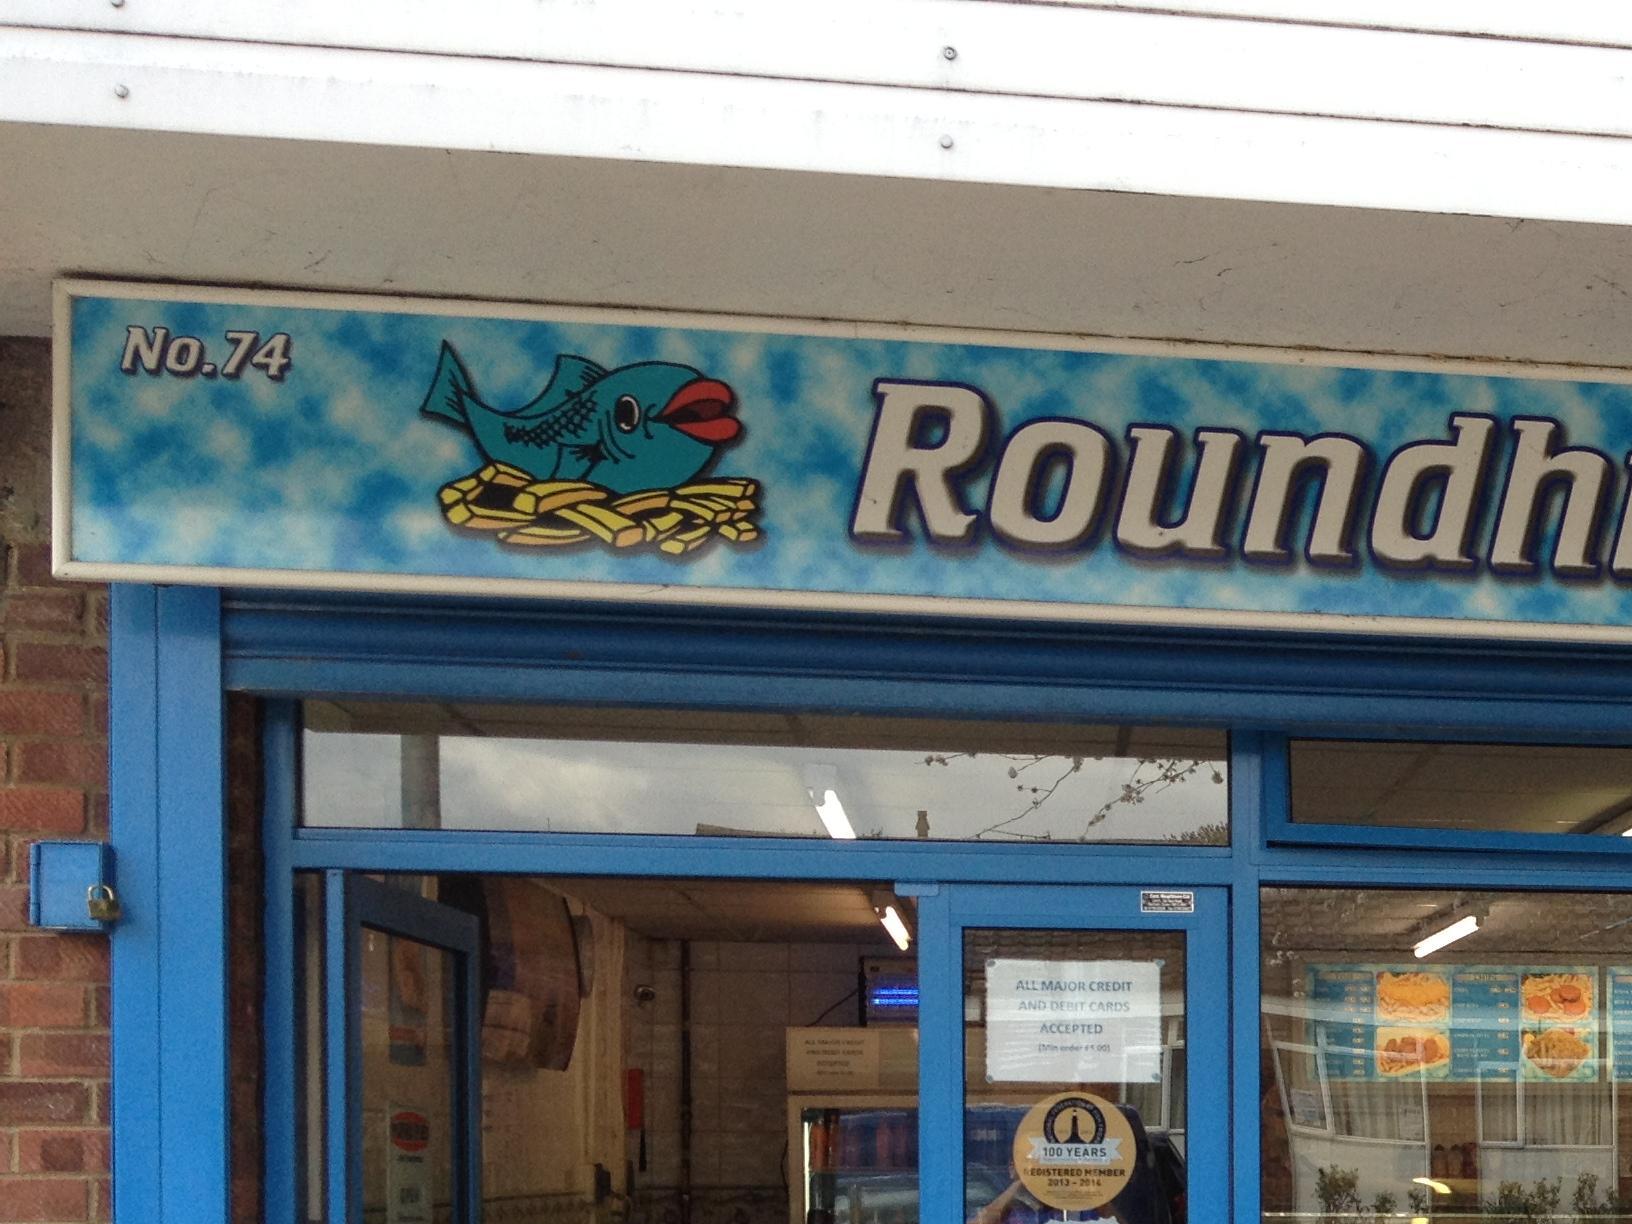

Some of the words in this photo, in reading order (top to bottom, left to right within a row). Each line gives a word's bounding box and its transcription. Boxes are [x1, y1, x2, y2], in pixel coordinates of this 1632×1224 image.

[121, 325, 291, 378] No.74
[1016, 980, 1038, 991] ALL
[1041, 981, 1086, 992] MAJOR
[1089, 982, 1133, 992] CREDIT
[1019, 1000, 1047, 1010] AND
[1050, 1001, 1085, 1011] DEBIT
[1089, 1002, 1130, 1012] CARDS
[1040, 1023, 1103, 1034] ACCEPTED
[1043, 1147, 1063, 1157] 100
[1066, 1147, 1107, 1157] YEARS
[1085, 1168, 1126, 1177] MEMBER
